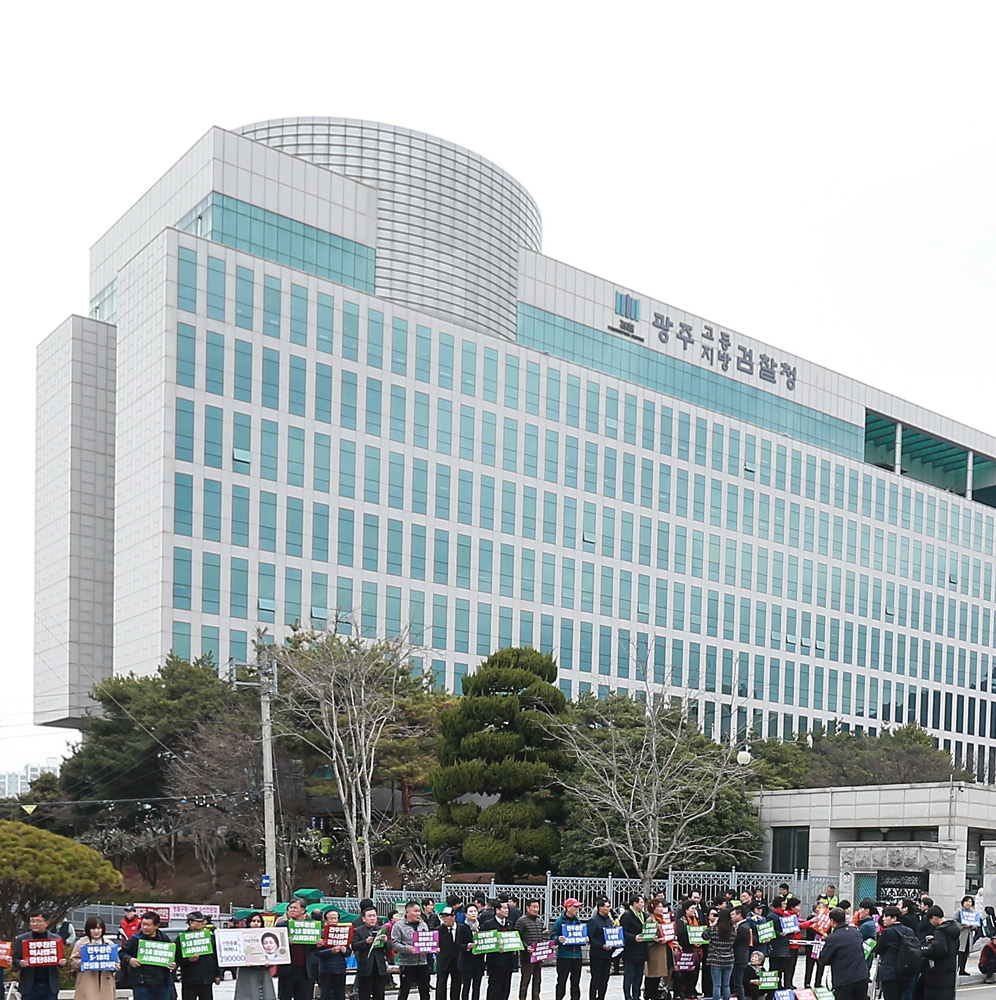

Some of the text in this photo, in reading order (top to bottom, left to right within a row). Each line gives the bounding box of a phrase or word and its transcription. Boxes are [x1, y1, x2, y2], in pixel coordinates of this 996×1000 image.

[652, 312, 694, 351] 광주
[701, 325, 731, 351] 고등
[737, 345, 797, 391] 검찰청
[701, 344, 731, 372] 지방
